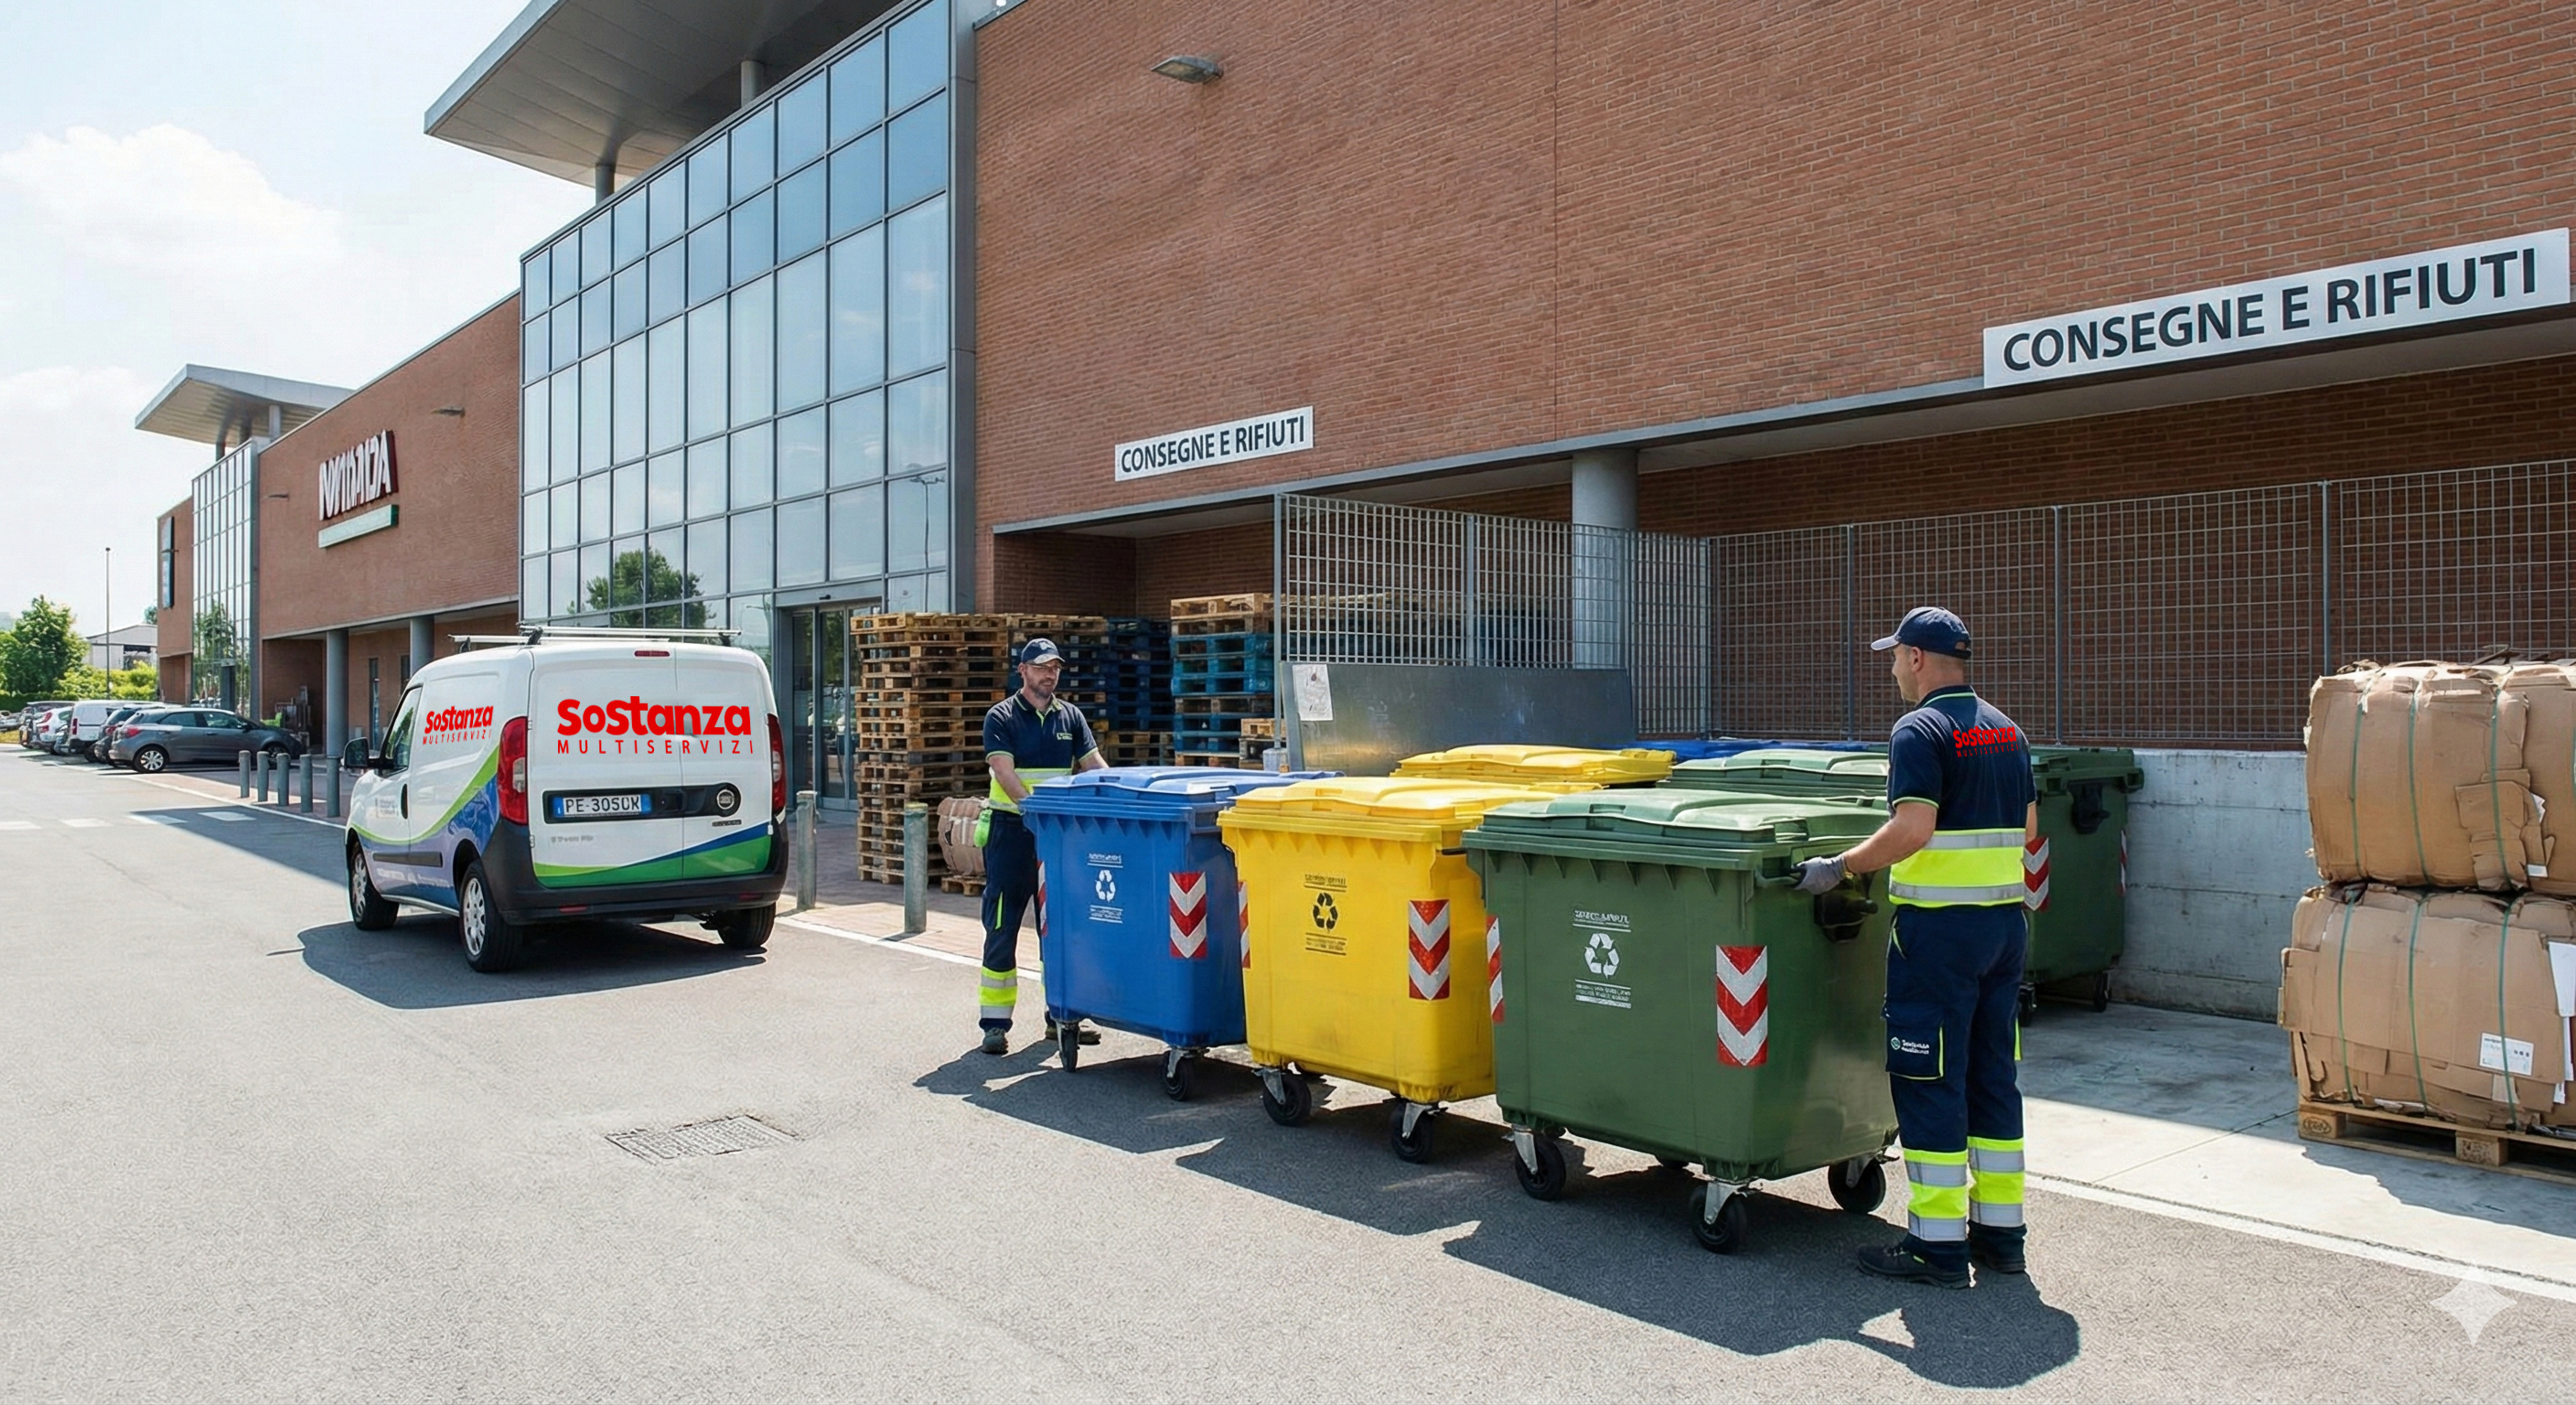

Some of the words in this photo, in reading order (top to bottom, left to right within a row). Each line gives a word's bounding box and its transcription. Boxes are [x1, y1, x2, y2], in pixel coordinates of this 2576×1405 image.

[2002, 293, 2266, 371] CONSEGNE
[2281, 285, 2311, 331] E
[2326, 247, 2536, 324] RIFIUTI
[1121, 433, 1216, 473] CONSEGNE
[1219, 430, 1230, 456] E
[1235, 415, 1304, 454] RIFIUTI
[422, 728, 492, 745] MULTISERVIZI
[557, 739, 754, 755] MULTISERVIZI
[1956, 743, 2019, 758] MULTISERVIZI
